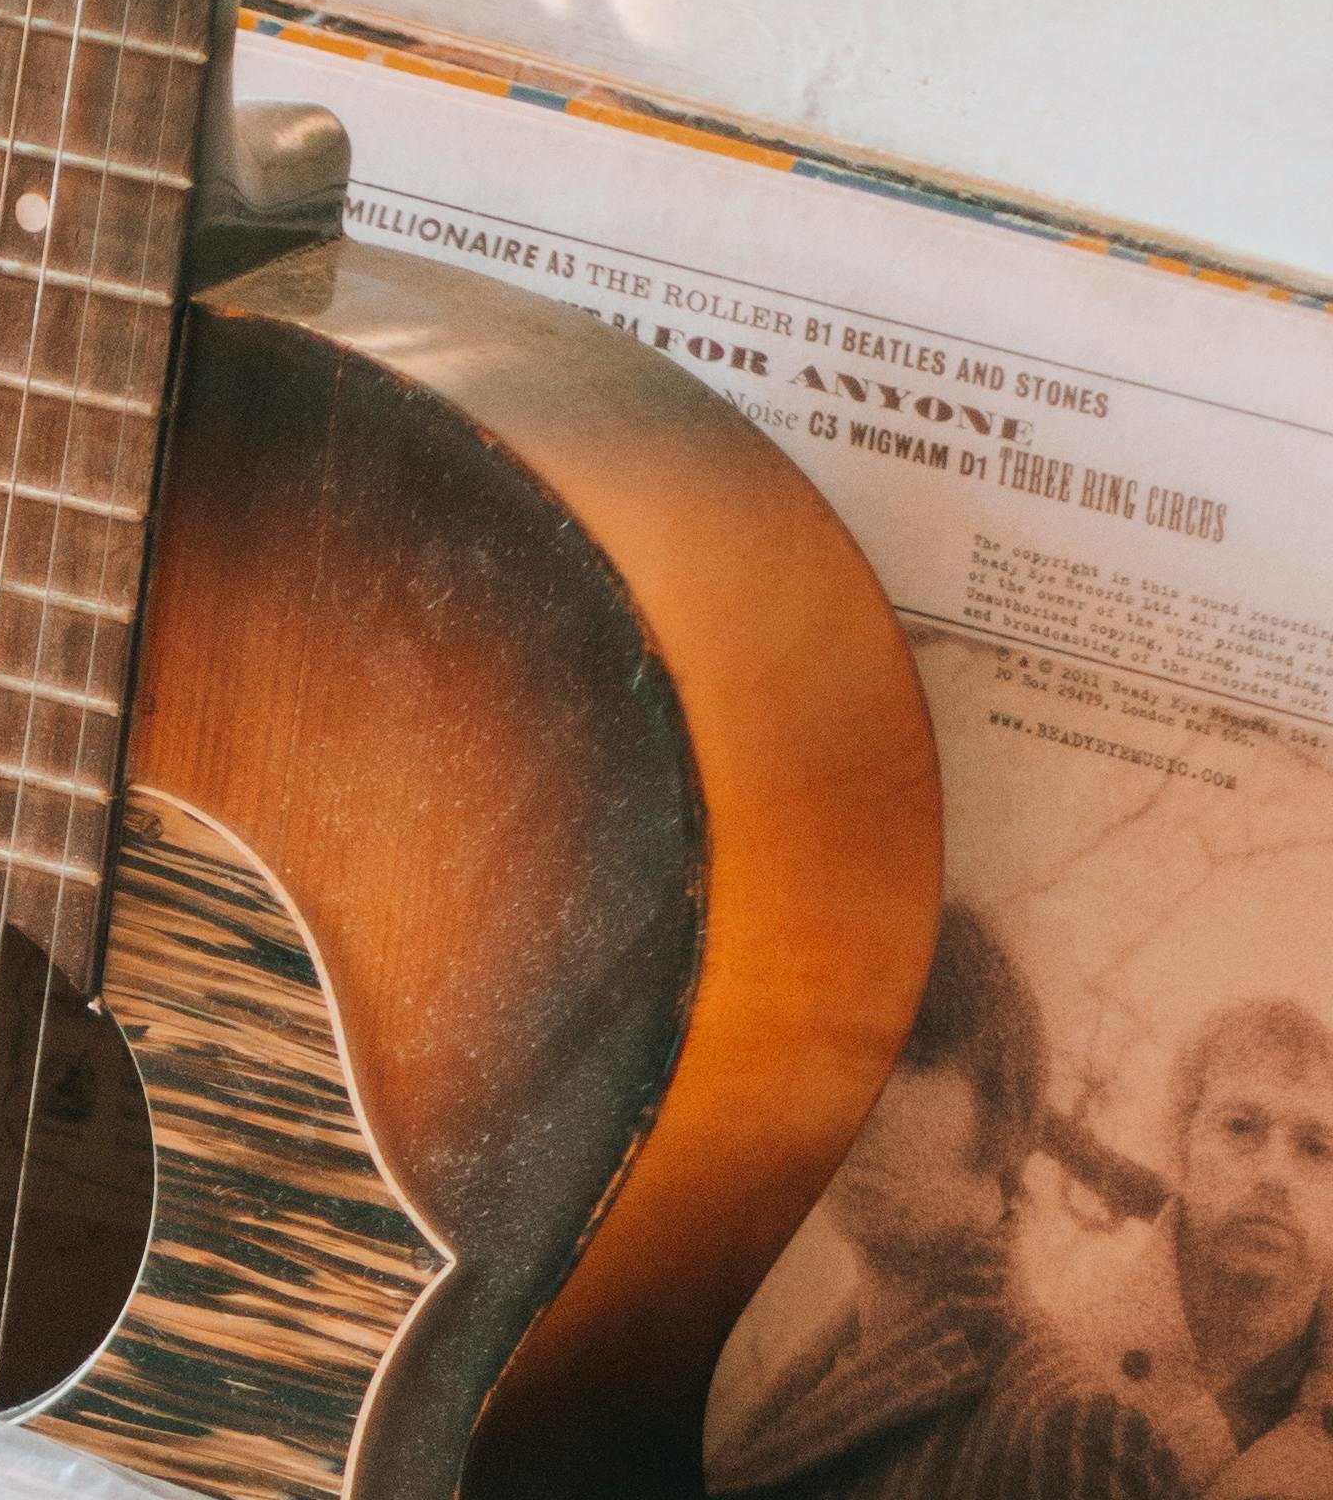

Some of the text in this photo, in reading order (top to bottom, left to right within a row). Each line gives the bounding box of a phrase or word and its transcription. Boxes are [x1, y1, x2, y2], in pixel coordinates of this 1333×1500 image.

[344, 197, 1109, 419] MILLIONAIRE A3 THE ROLLER B1 BEATLES AND STONES
[652, 323, 772, 377] FOR
[786, 363, 1036, 447] ANYONE
[722, 387, 1228, 543] Noise C3 WIGWAM D1 THREE RING CIRCUS
[966, 586, 1078, 628] Unauthorised
[972, 551, 1017, 577] Beady
[1029, 568, 1056, 584] Eye
[1066, 576, 1134, 605] Records
[1229, 624, 1286, 646] rights
[974, 533, 1000, 551] The
[1013, 548, 1099, 578] copyright
[1111, 572, 1130, 586] in
[1141, 579, 1179, 599] this
[1190, 594, 1239, 616] sound
[999, 577, 1026, 595] the
[1037, 590, 1085, 611] owner
[1127, 612, 1154, 629] the
[1166, 625, 1204, 643] work
[963, 606, 991, 622] and
[1003, 614, 1120, 659] broadcasting
[1161, 658, 1189, 675] the
[1021, 673, 1048, 693] Box
[1120, 700, 1175, 727] London
[1061, 667, 1100, 689] 2011
[1111, 679, 1159, 706] Beady
